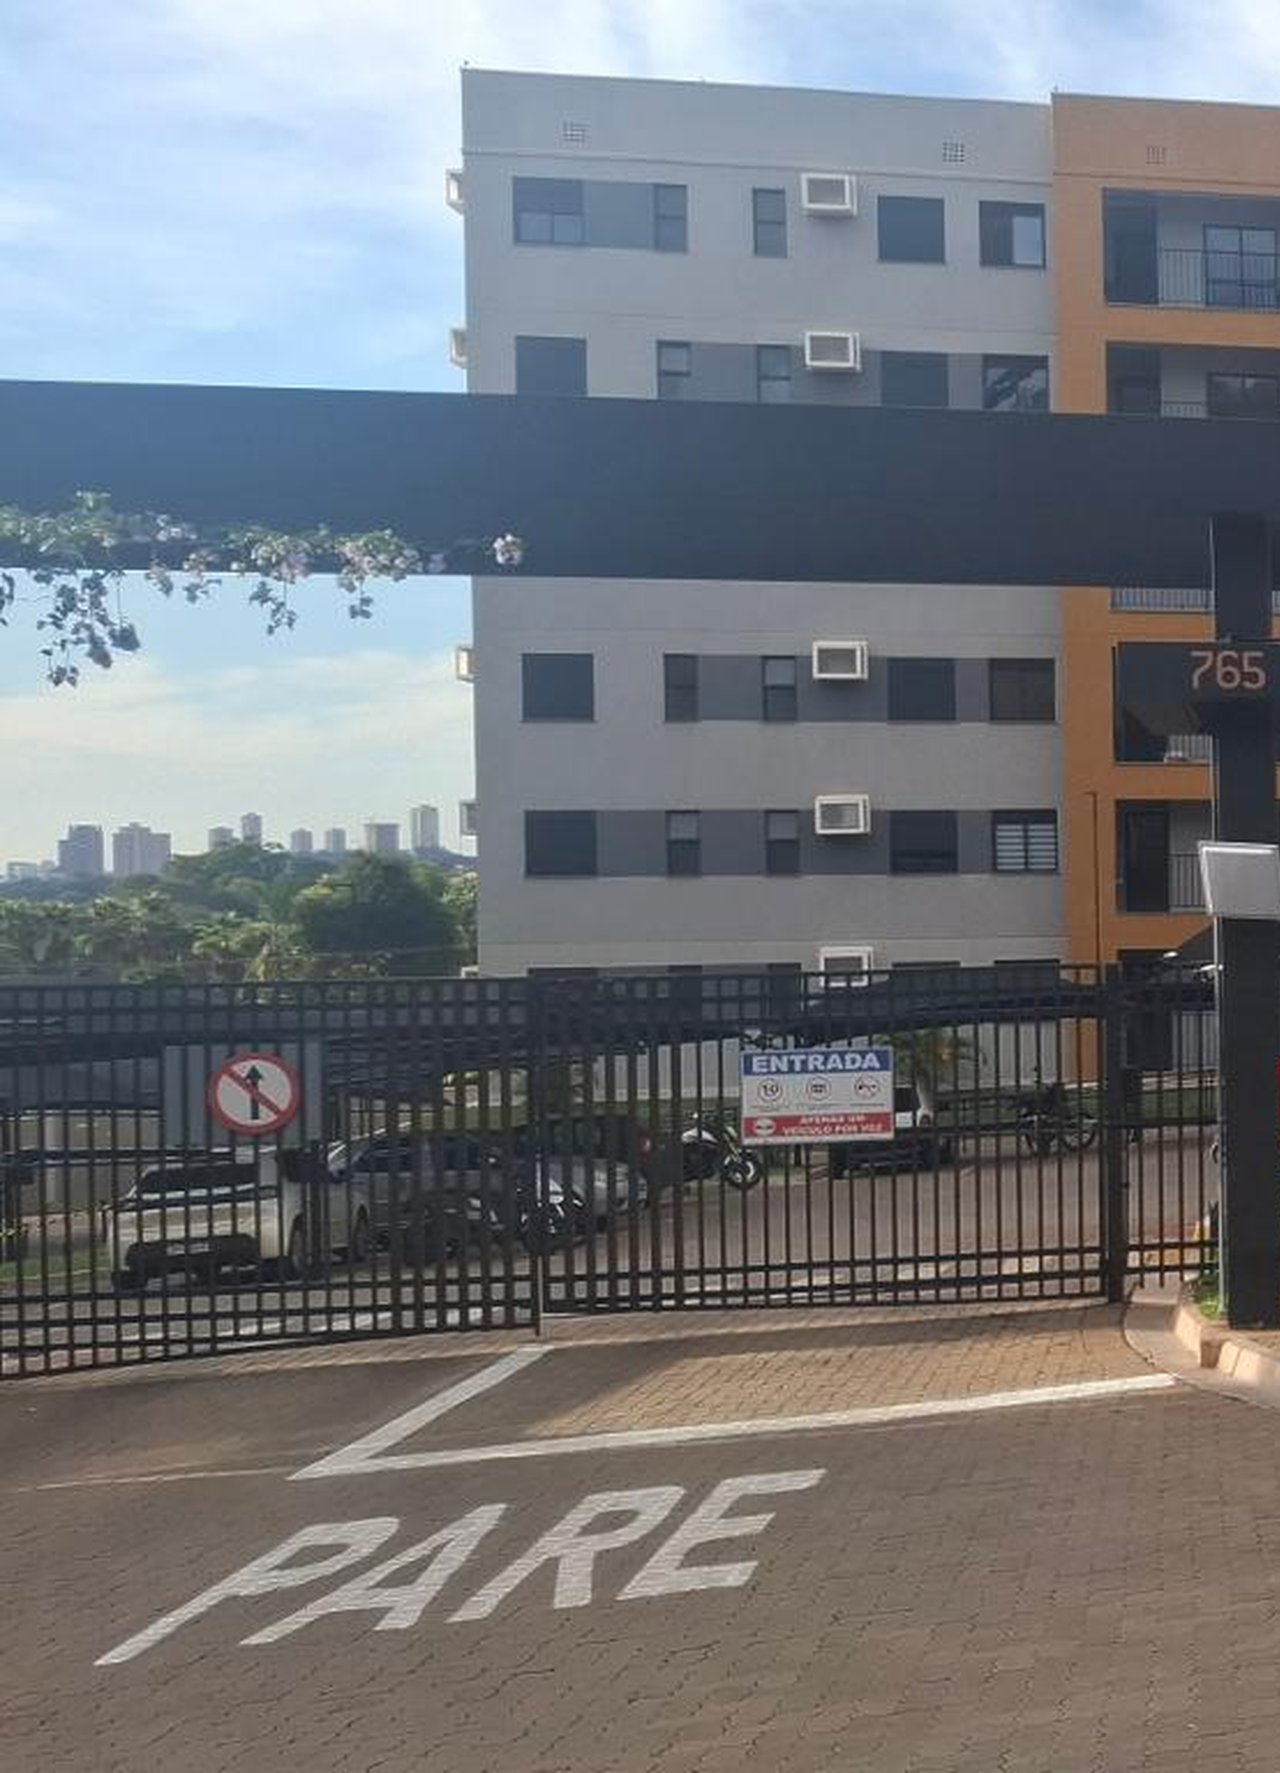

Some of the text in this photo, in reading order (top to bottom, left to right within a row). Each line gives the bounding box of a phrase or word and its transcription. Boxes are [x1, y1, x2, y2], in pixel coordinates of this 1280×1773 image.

[1190, 651, 1267, 689] 765
[752, 1053, 881, 1073] ENTRADA
[93, 1468, 827, 1666] PARE
